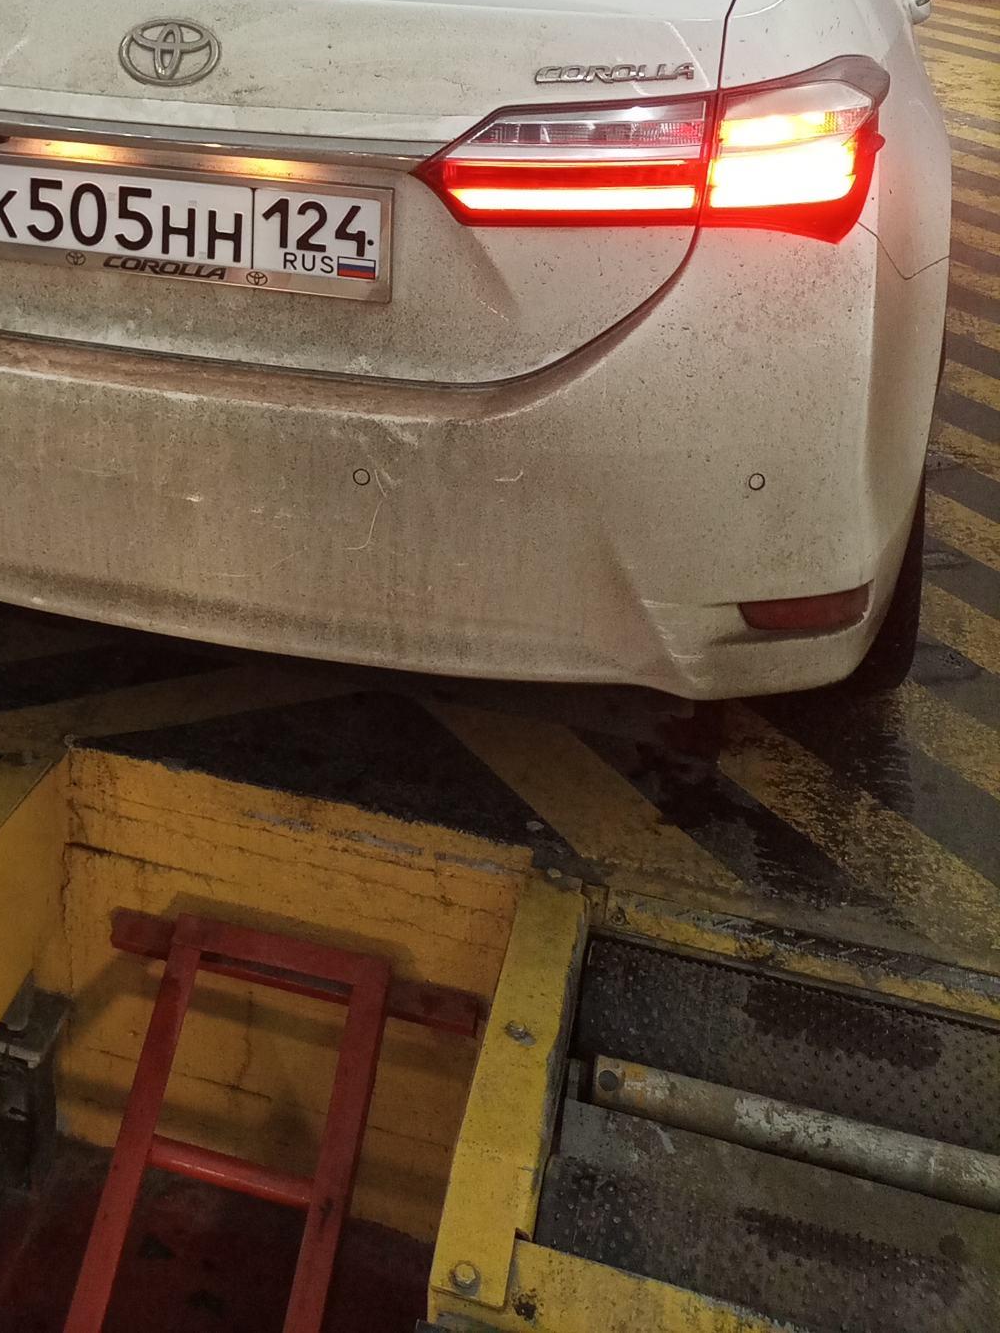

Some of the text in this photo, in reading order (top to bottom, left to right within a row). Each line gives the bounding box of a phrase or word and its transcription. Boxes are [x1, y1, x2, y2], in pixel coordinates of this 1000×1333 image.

[534, 62, 695, 84] COROLLA
[261, 198, 368, 257] 124
[102, 253, 227, 282] COROLLA
[283, 251, 335, 274] RUS
